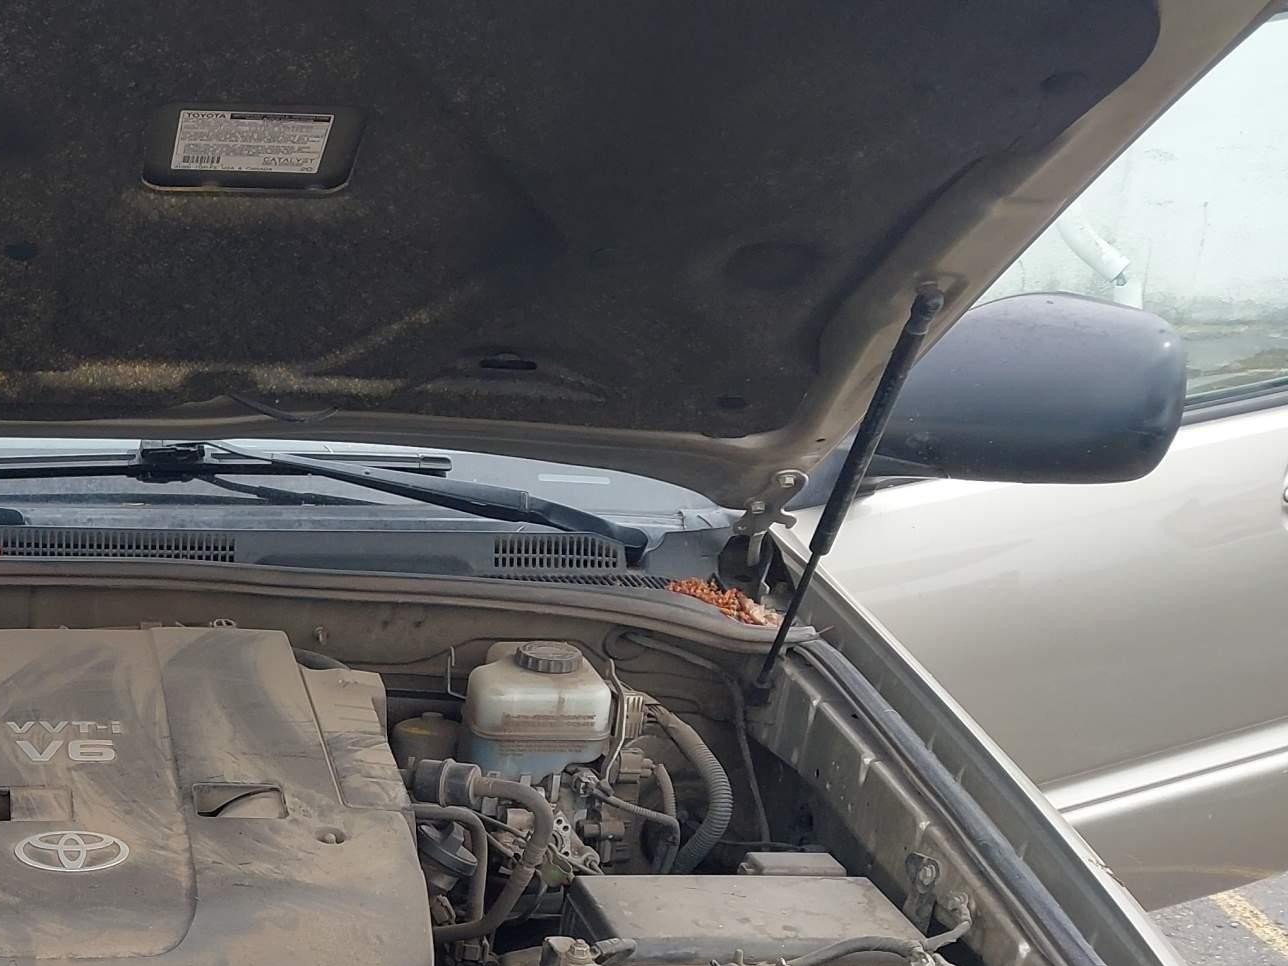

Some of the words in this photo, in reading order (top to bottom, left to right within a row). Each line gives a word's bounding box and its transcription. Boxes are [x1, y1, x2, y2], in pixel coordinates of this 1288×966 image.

[263, 156, 315, 164] CATALYST
[6, 721, 121, 734] VVT-i
[16, 740, 116, 762] V6
